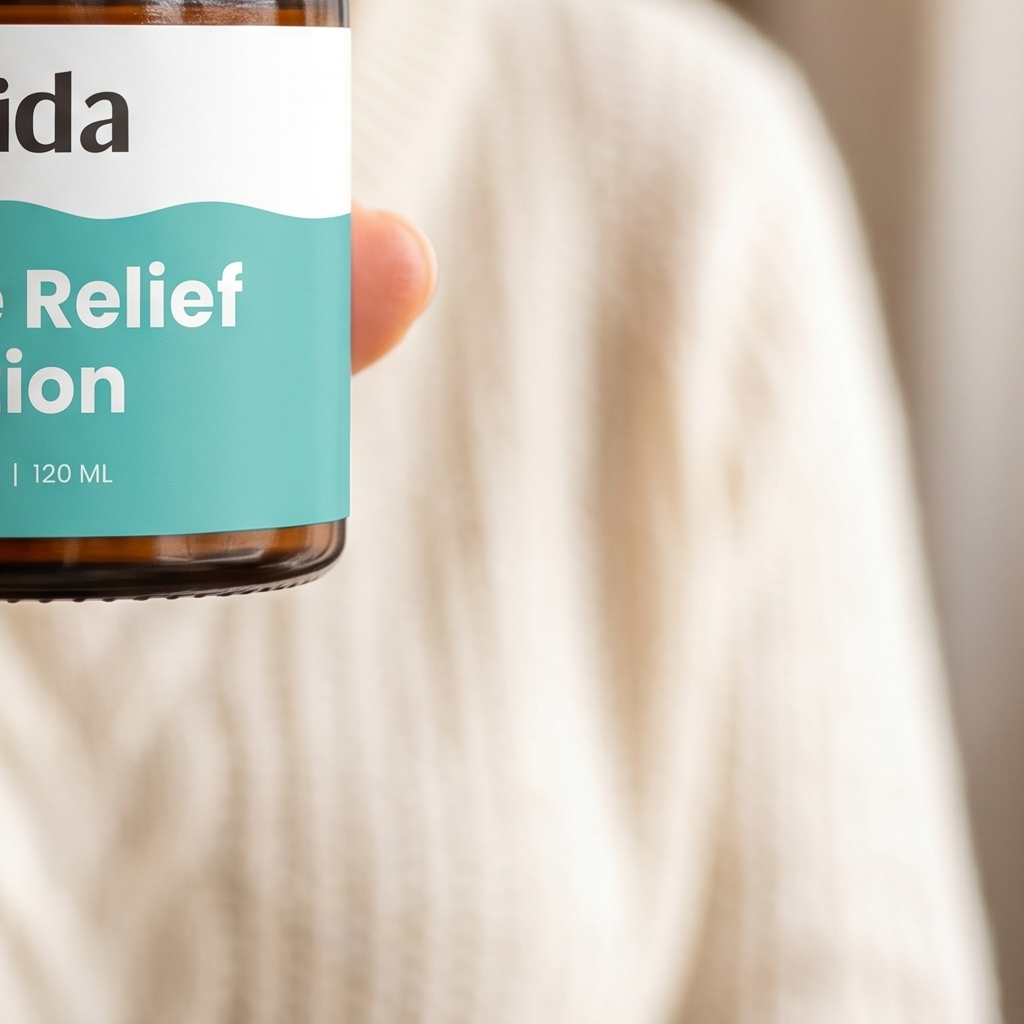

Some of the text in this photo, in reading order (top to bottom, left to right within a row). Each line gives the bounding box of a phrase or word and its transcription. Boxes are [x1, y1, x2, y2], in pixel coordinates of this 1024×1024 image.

[26, 261, 244, 329] Relief
[33, 463, 72, 484] 120
[80, 463, 113, 484] ML
